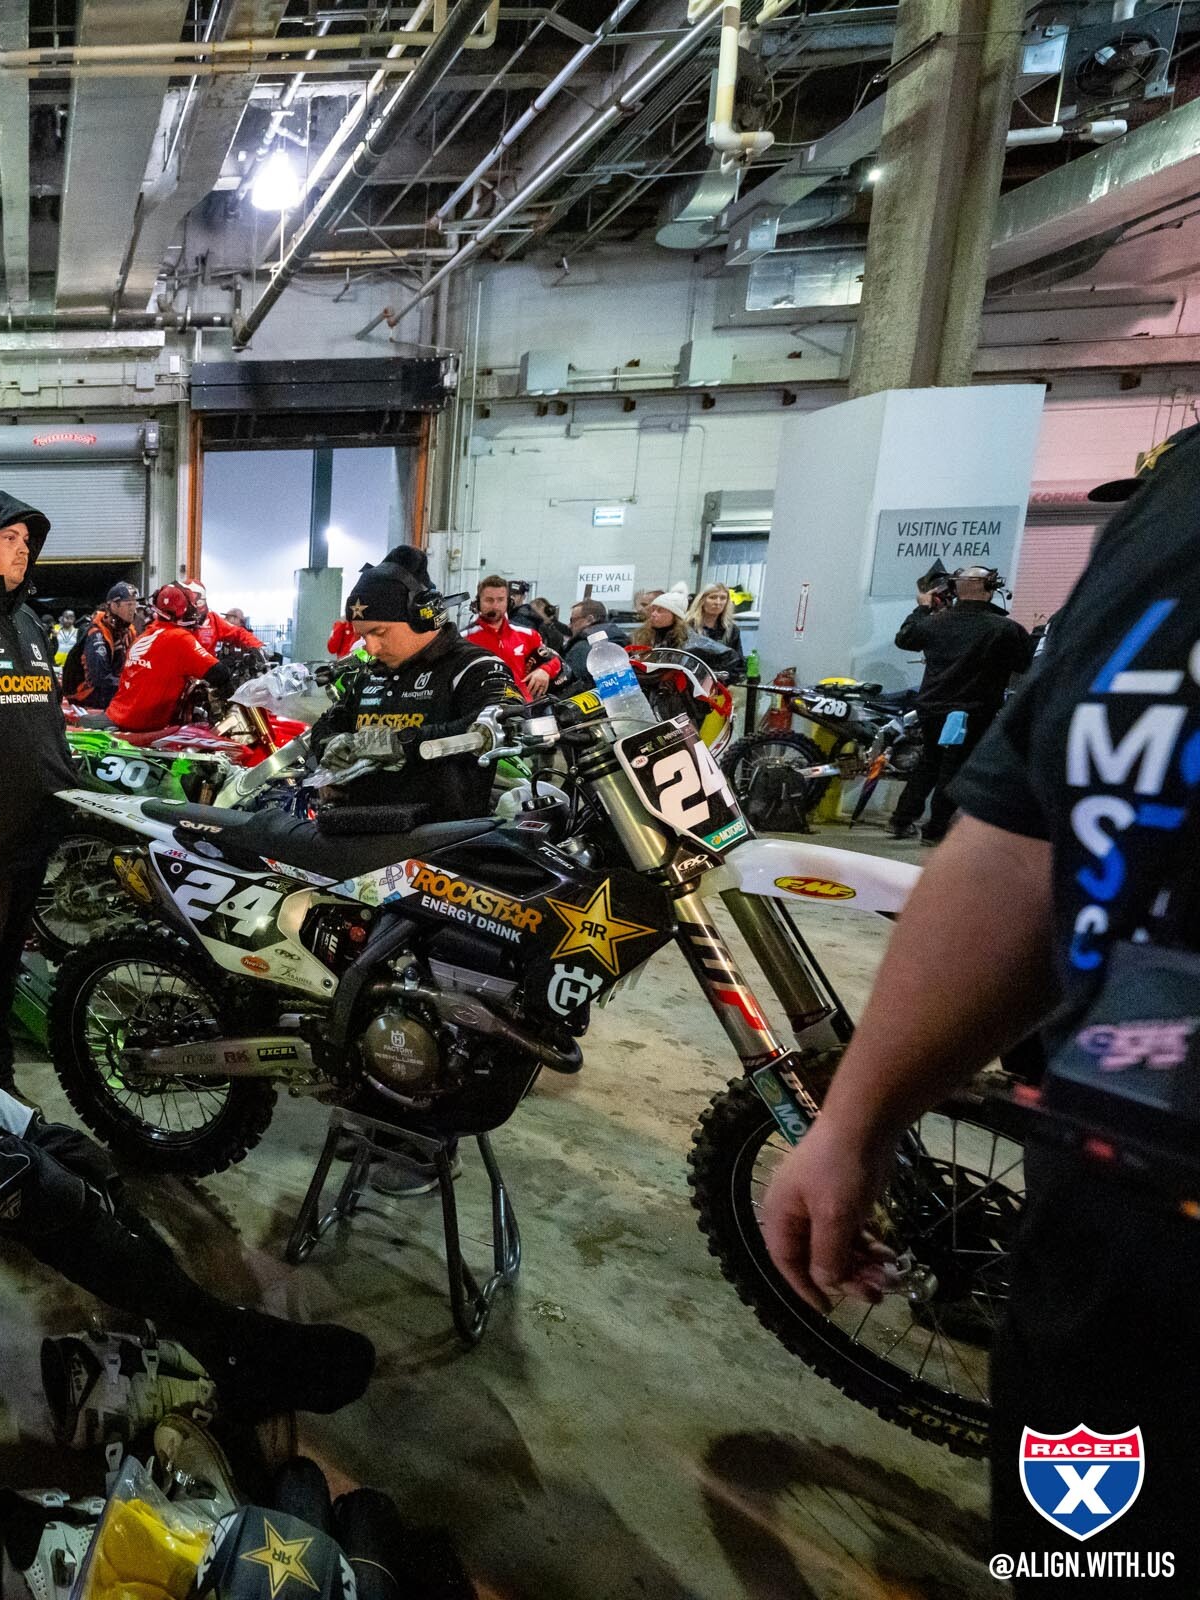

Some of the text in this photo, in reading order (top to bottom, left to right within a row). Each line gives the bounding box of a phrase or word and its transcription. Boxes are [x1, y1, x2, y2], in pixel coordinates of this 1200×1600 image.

[897, 520, 1002, 537] VISITING TEAM
[897, 541, 991, 557] FAMILY AREA
[579, 572, 633, 582] KEEP WALL
[810, 696, 847, 718] 238
[356, 713, 425, 730] ROCKSTAR
[96, 755, 149, 788] 30
[73, 796, 124, 815] DUNLOP
[179, 819, 224, 834] GUTS
[172, 869, 284, 937] 24
[411, 866, 543, 934] ROCKSTAR
[421, 895, 523, 944] ENERGY DRINK
[259, 1047, 296, 1057] EXCEL
